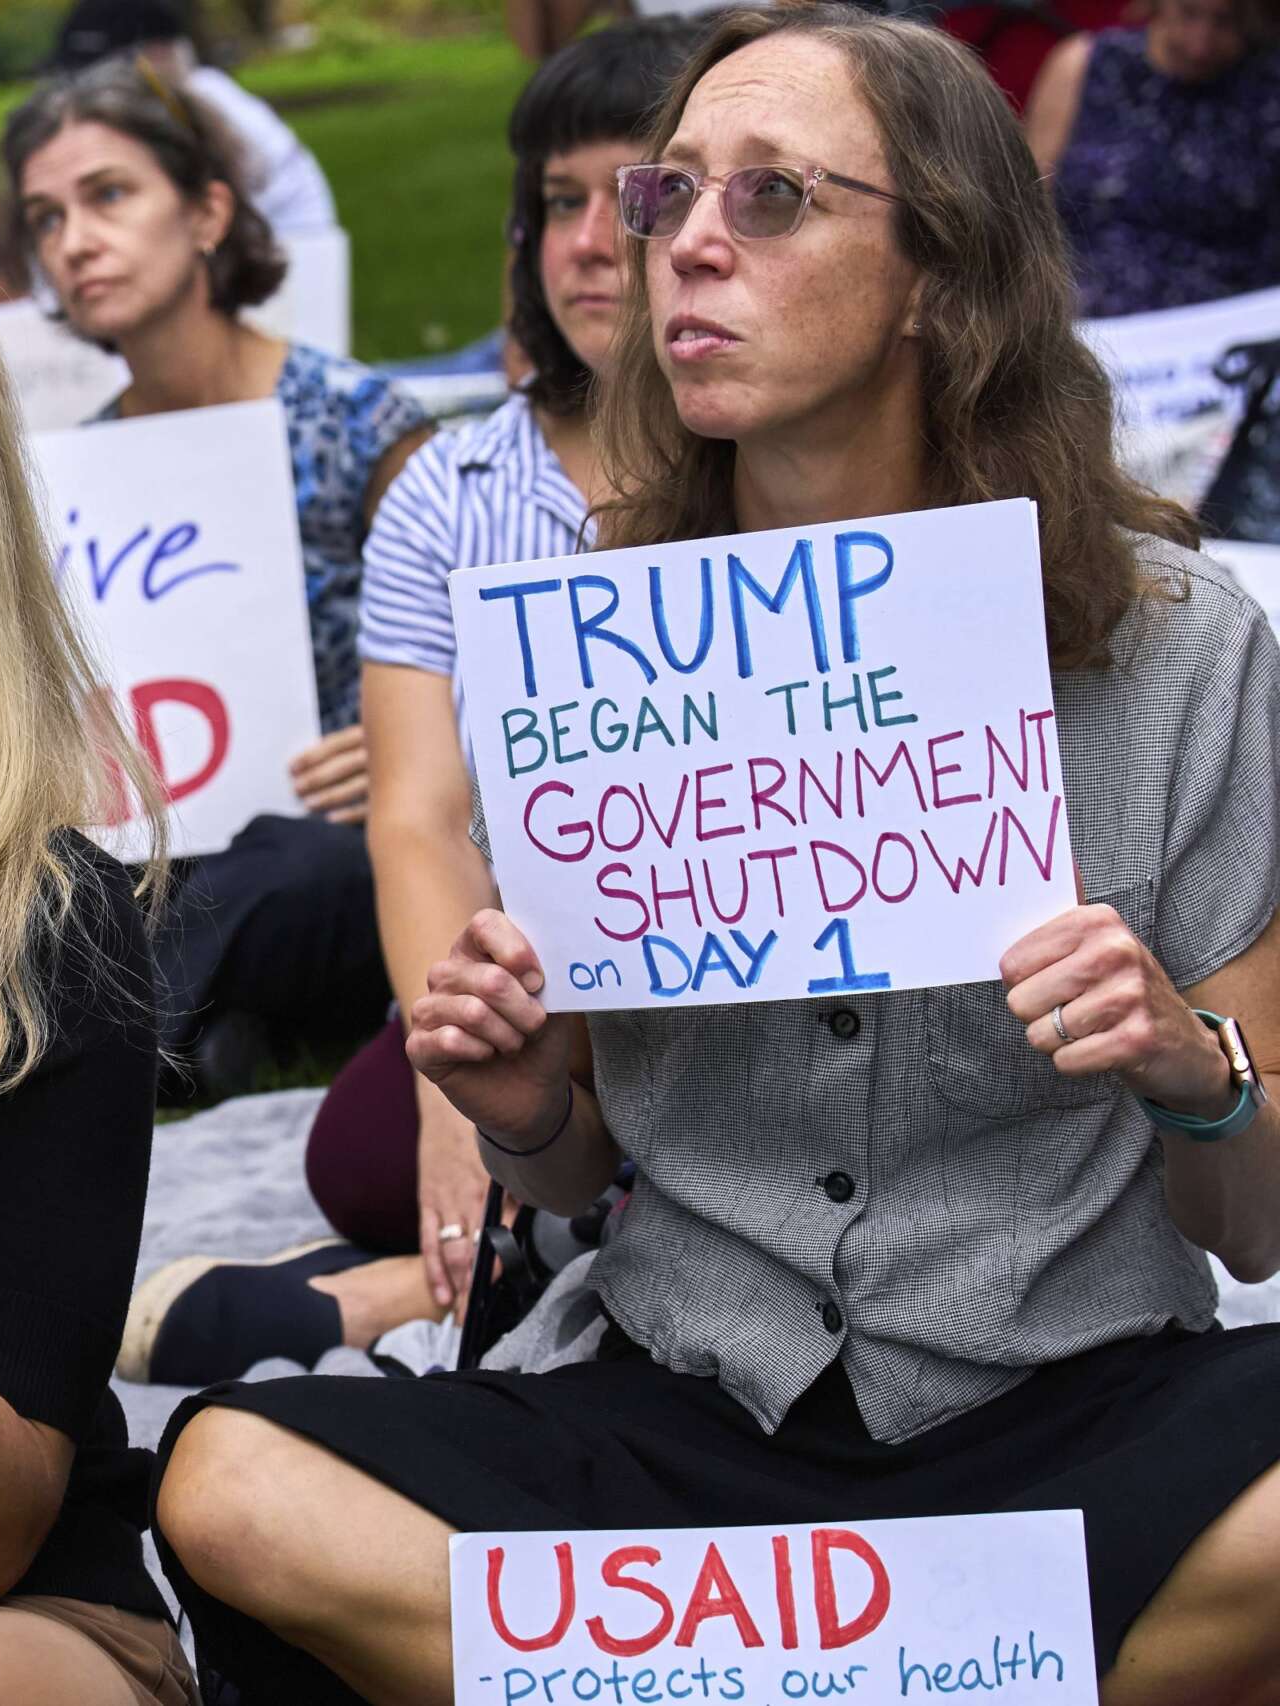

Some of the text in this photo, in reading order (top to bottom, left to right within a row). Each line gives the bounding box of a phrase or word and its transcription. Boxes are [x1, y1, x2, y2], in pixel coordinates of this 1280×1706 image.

[479, 531, 894, 698] TRUMP
[501, 665, 918, 779] BEGAN THE
[523, 708, 1055, 864] GOVERNMENT
[594, 795, 1062, 942] SHUTDOWN
[568, 918, 892, 998] on DAY 1
[487, 1529, 891, 1657] USAID
[781, 1667, 870, 1696] our
[899, 1631, 1063, 1695] health
